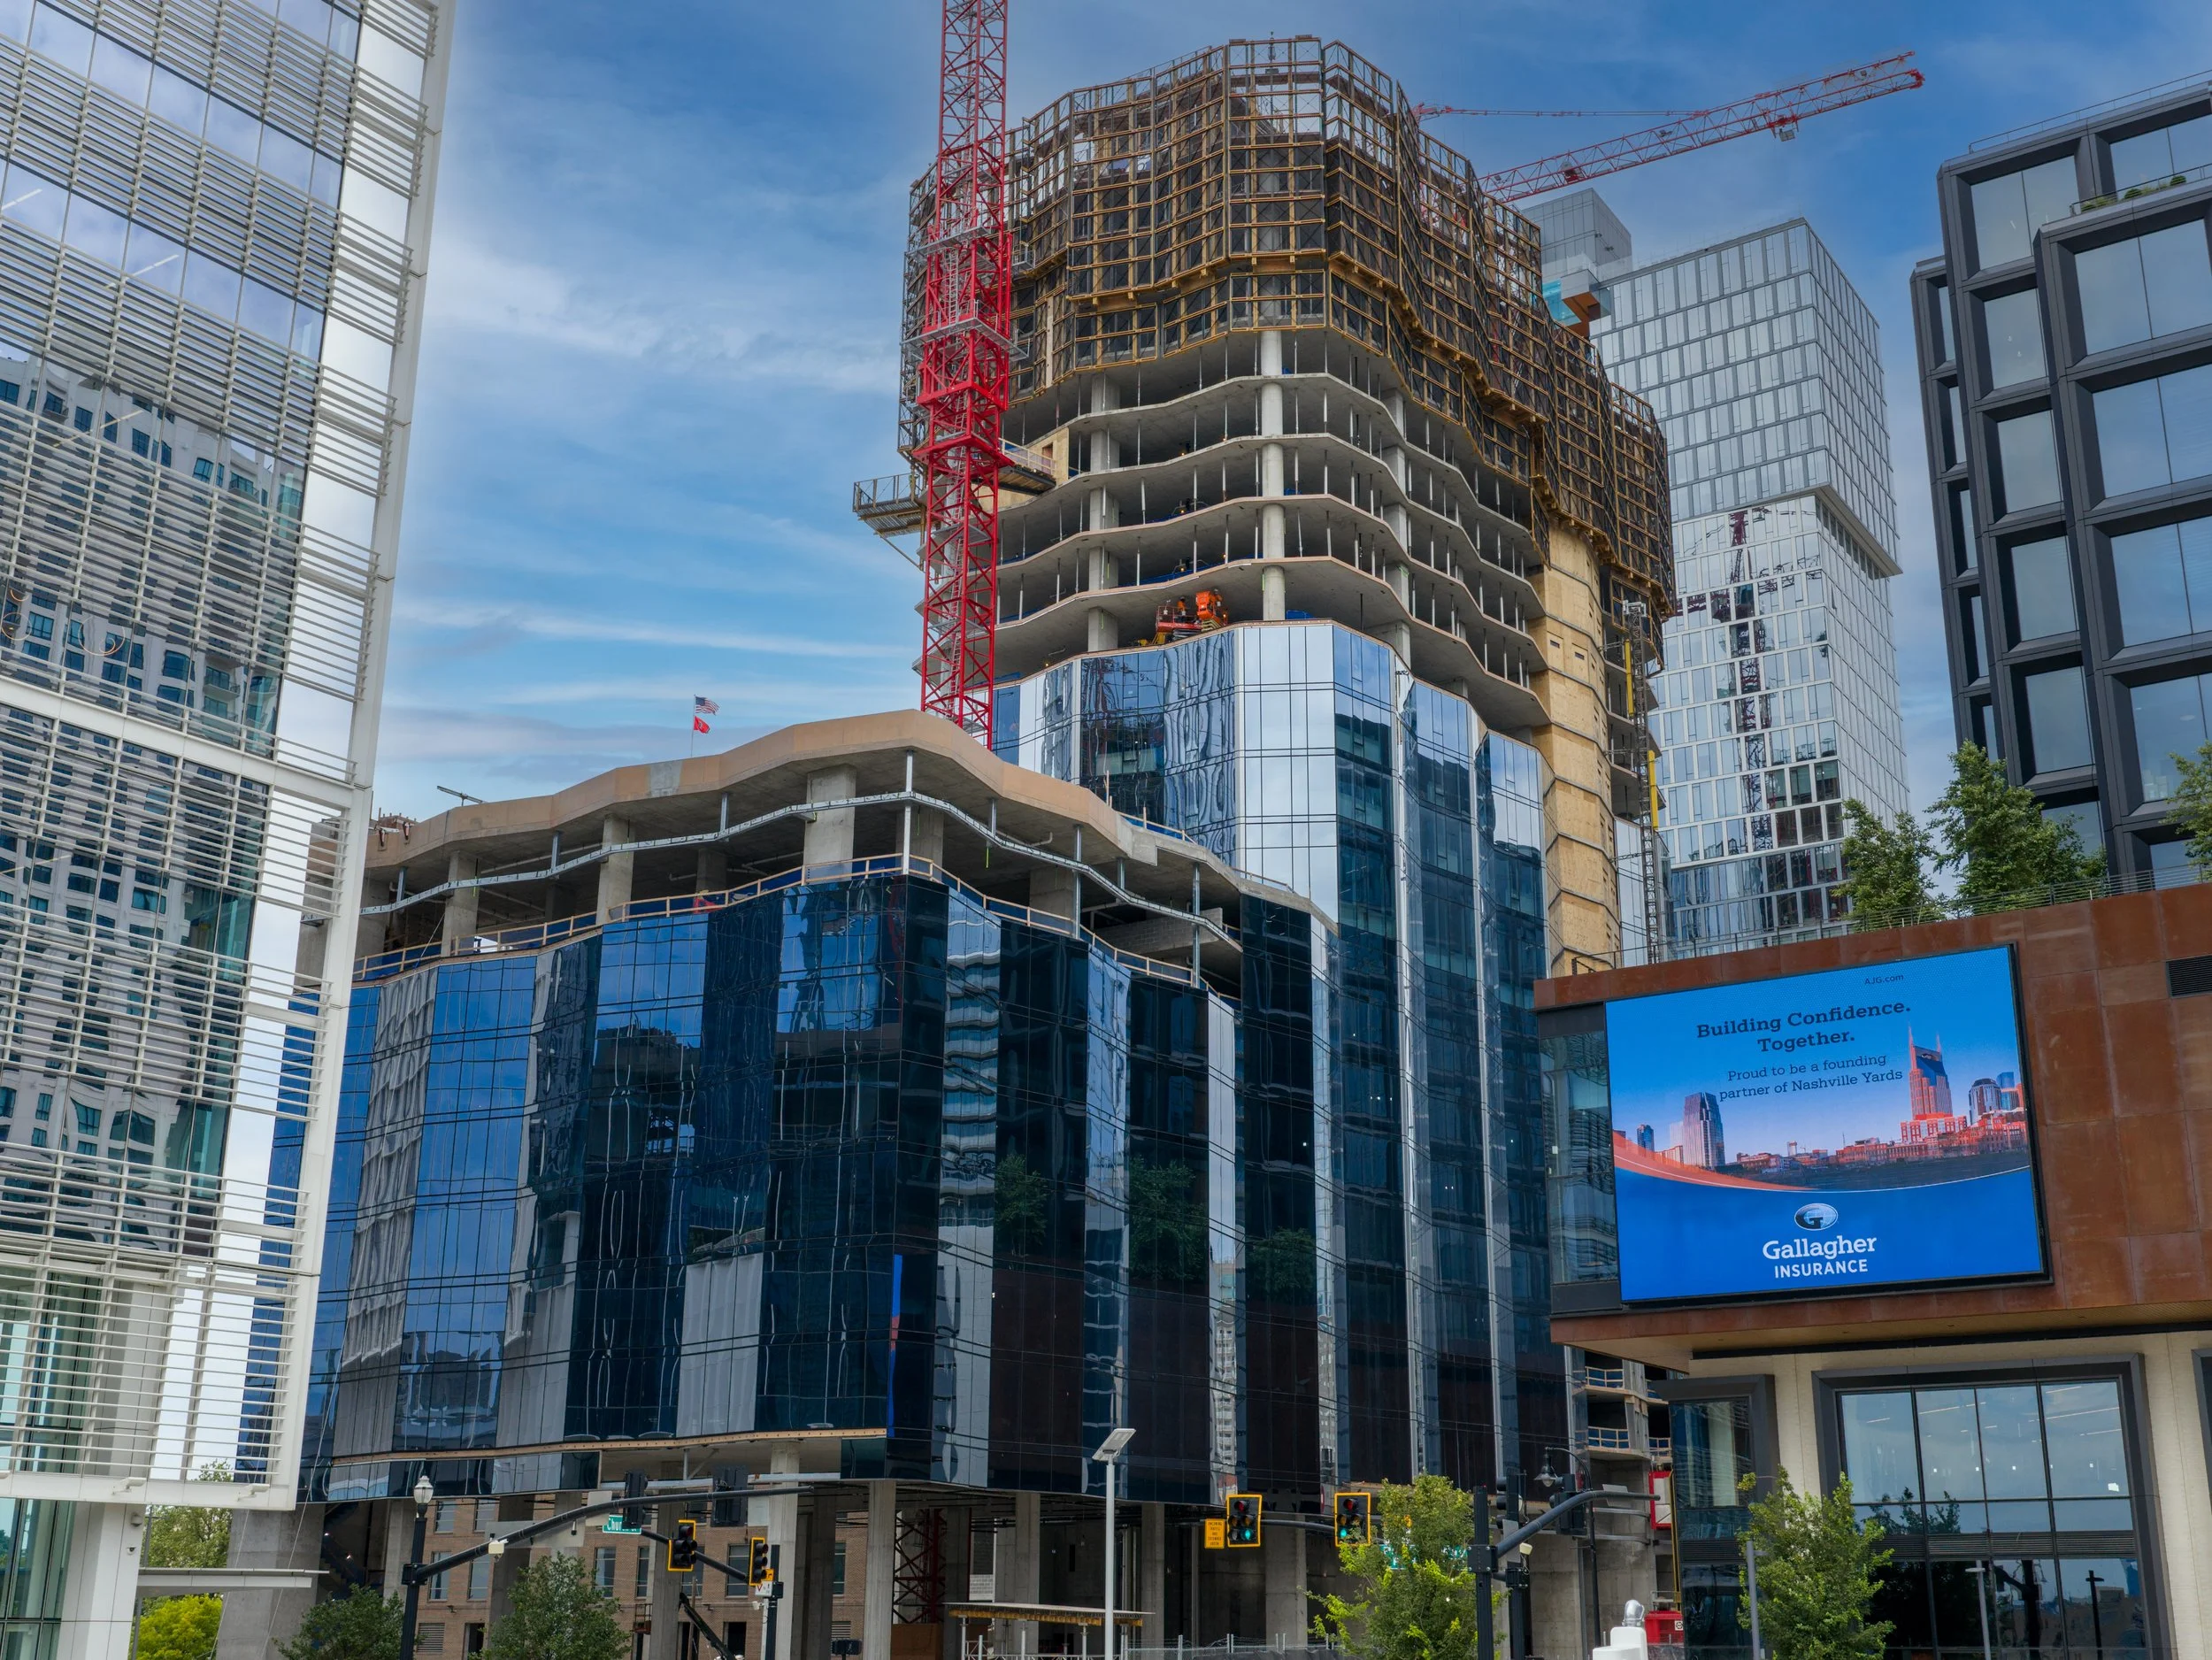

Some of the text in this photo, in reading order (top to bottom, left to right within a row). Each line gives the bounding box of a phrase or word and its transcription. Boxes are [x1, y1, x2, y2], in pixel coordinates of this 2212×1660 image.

[1864, 974, 1904, 985] AJG.com
[1696, 1002, 1911, 1038] Building Confidence.
[1757, 1031, 1855, 1052] Together.
[1727, 1055, 1887, 1081] Proud to be a founding
[1719, 1069, 1903, 1102] partner of Nashville Yards
[1762, 1235, 1878, 1260] Gallagher
[1774, 1258, 1868, 1279] INSURANCE
